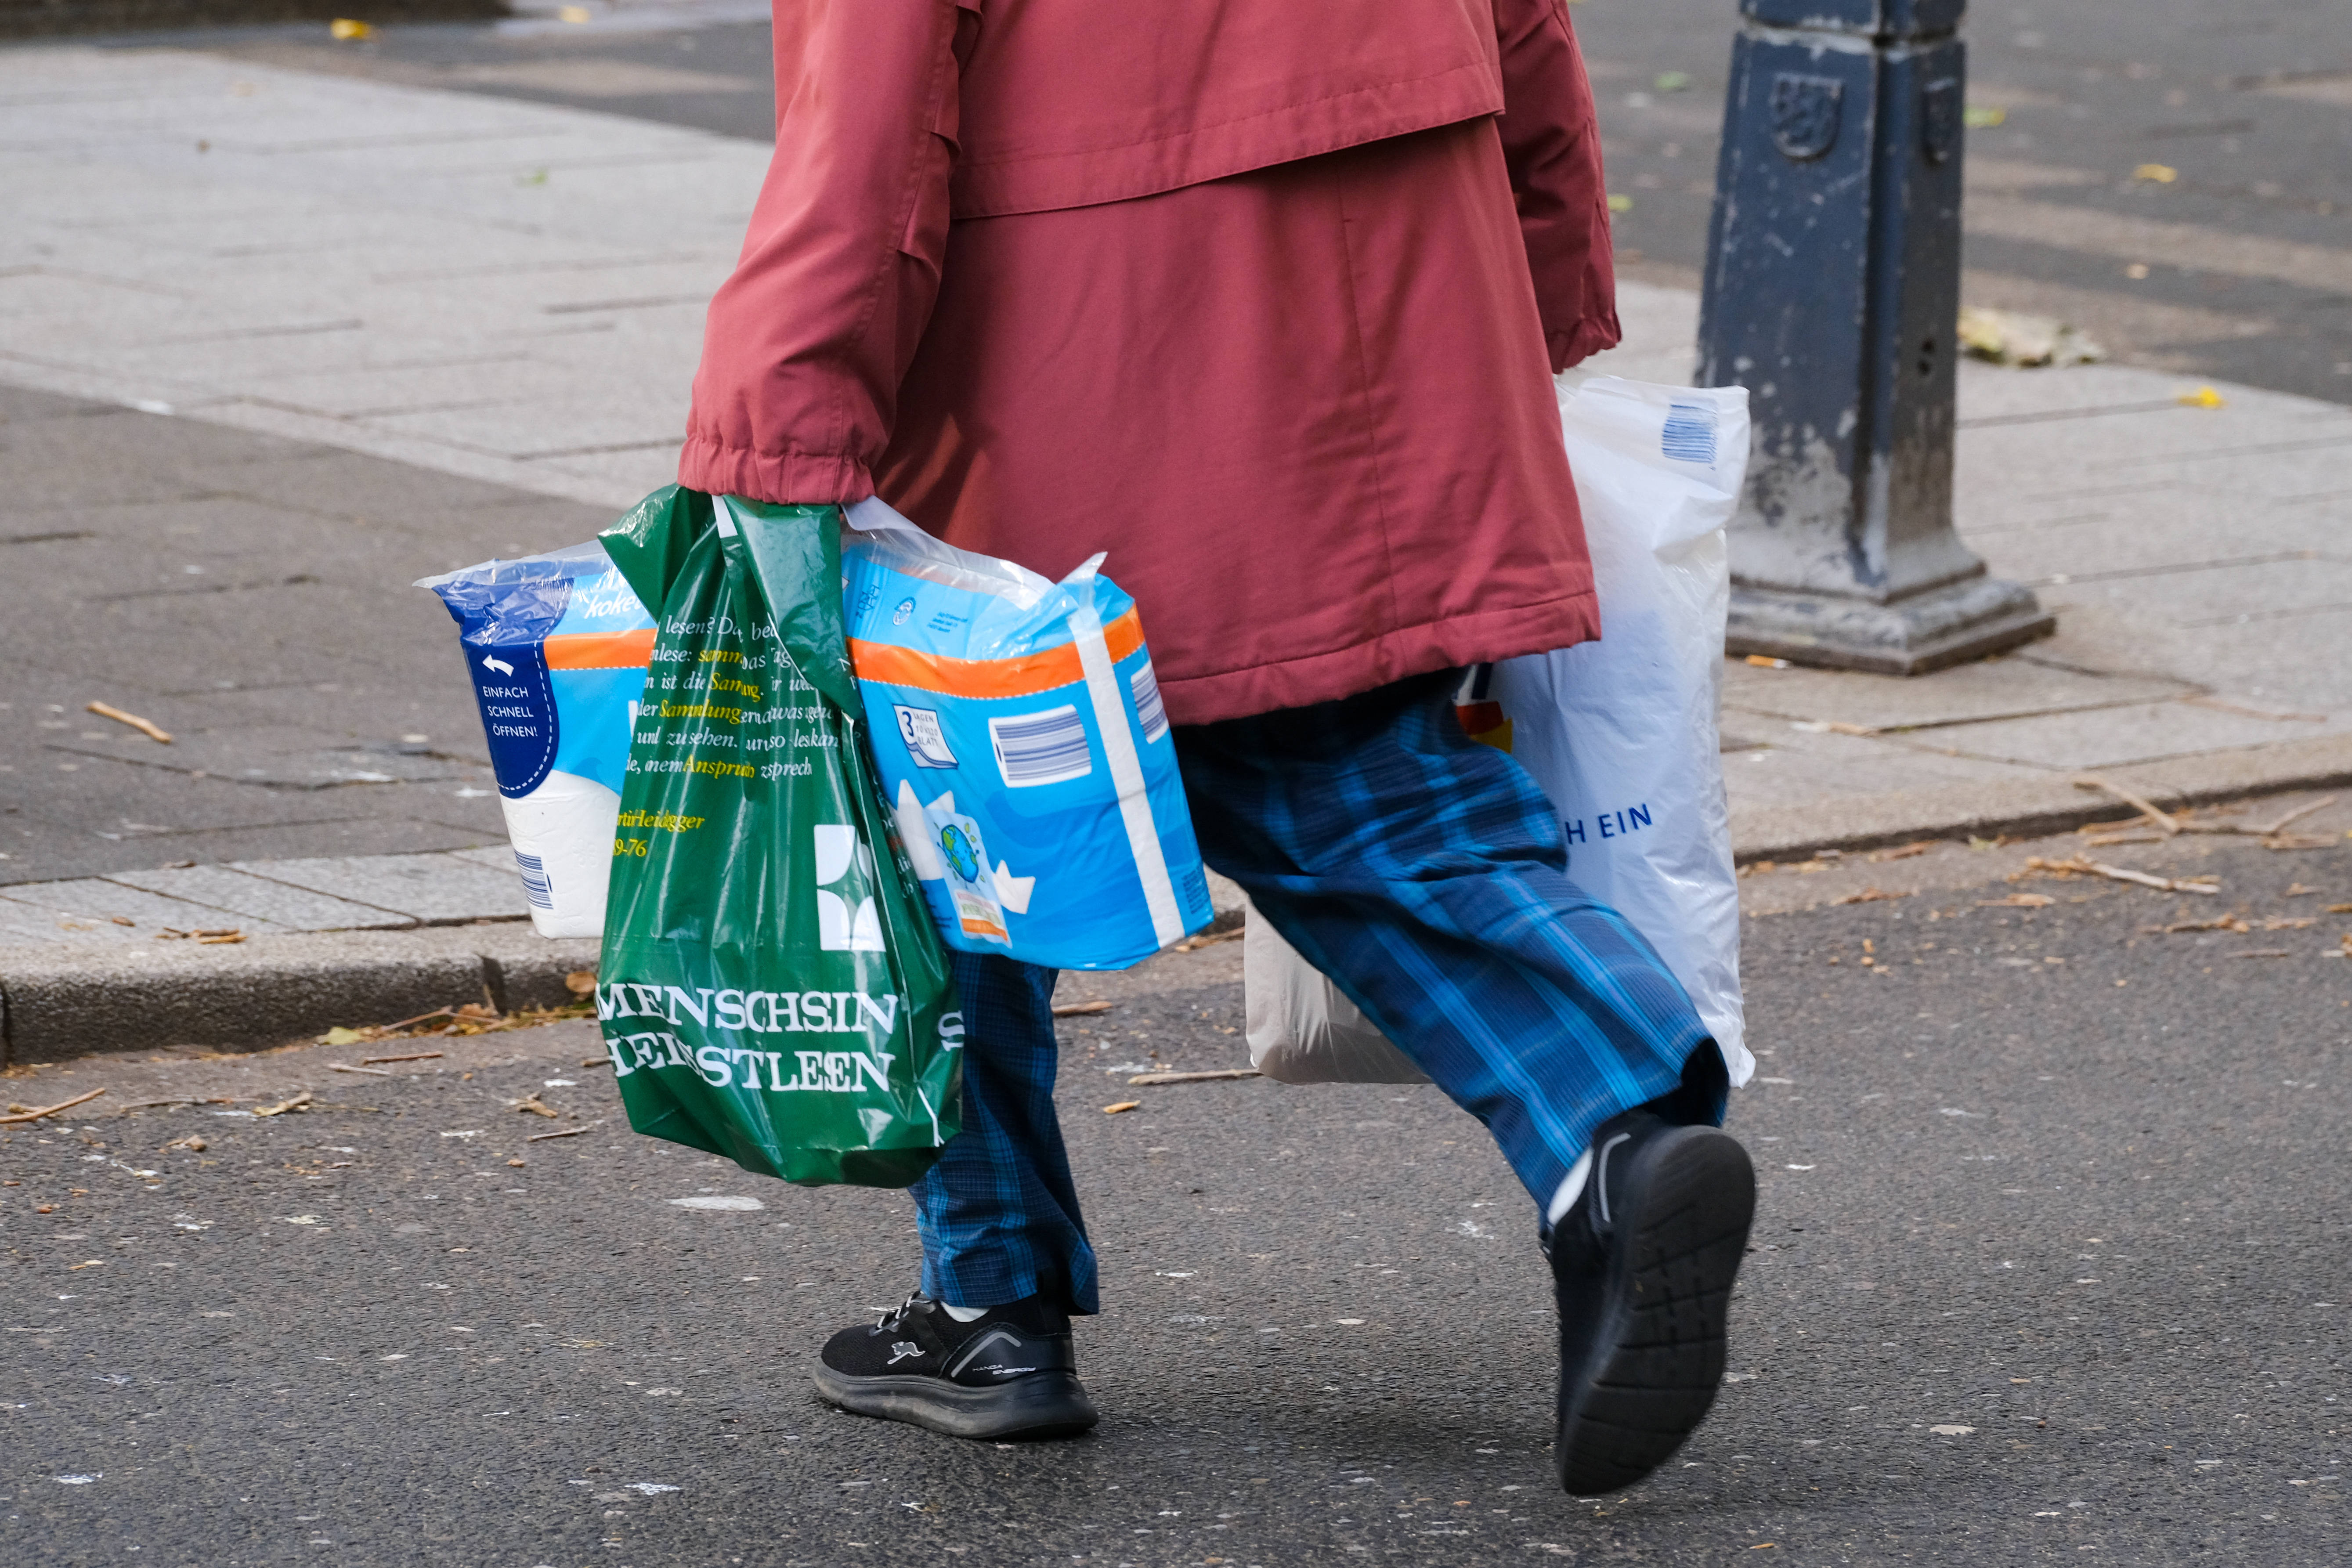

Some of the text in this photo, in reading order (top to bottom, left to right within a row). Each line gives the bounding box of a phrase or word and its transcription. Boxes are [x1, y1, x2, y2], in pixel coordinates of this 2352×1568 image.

[661, 672, 678, 690] ist
[483, 686, 529, 698] EINFACH
[487, 705, 534, 717] SCHNELL
[492, 723, 538, 737] ÖFFNEN!
[902, 711, 914, 737] 3
